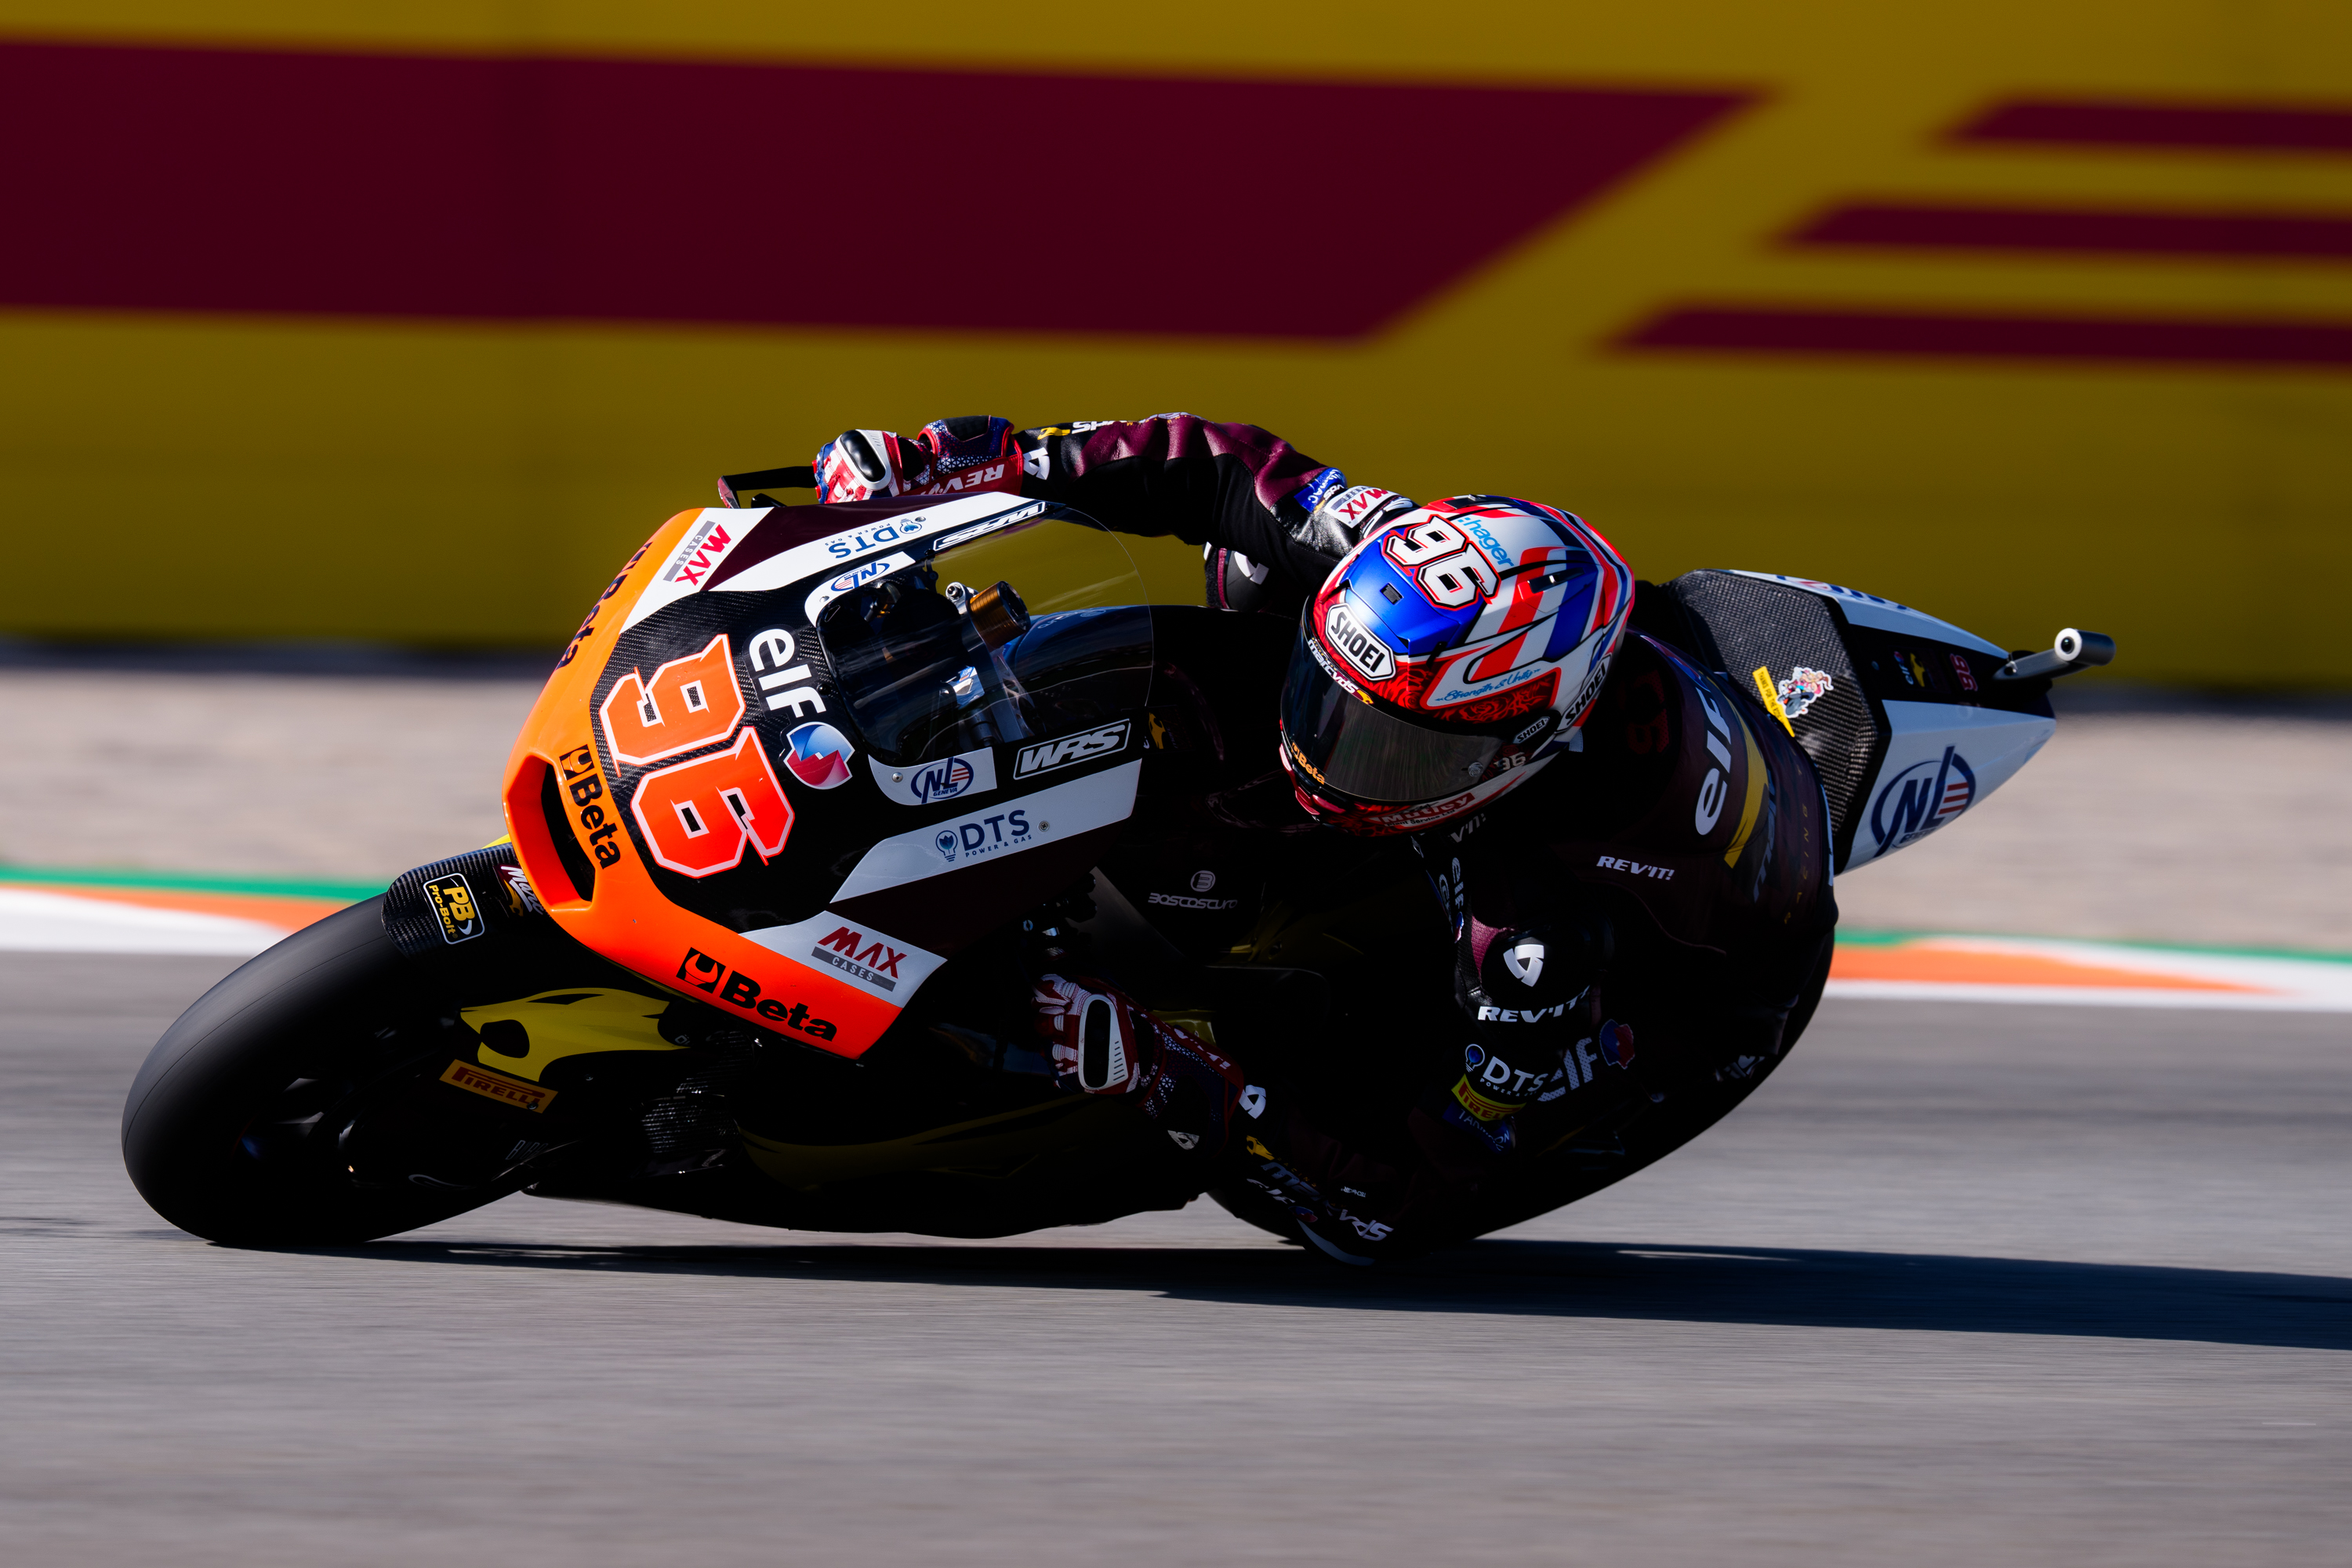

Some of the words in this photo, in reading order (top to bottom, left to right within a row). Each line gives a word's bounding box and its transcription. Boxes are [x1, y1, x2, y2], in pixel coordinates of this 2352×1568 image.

[1338, 488, 1388, 521] MAX
[828, 526, 899, 558] DTS
[865, 523, 890, 534] POWER
[938, 503, 1039, 549] WRS
[674, 524, 732, 586] MAX
[676, 535, 703, 566] CASES
[1382, 514, 1501, 612] 96
[1330, 612, 1386, 673] SHOEI
[749, 628, 826, 718] elf
[1949, 653, 1979, 691] 96
[1564, 662, 1606, 725] SHOEI
[1019, 724, 1127, 774] WRS
[1517, 719, 1545, 742] SHOEI
[599, 633, 795, 878] 96
[1494, 751, 1526, 772] 96
[1694, 687, 1733, 836] elf
[933, 786, 958, 797] GENEVA
[568, 772, 621, 869] Beta
[960, 810, 1030, 851] DTS
[965, 844, 999, 858] POWER
[1014, 834, 1033, 844] GAS
[1596, 855, 1675, 880] REV'IT!
[443, 886, 476, 922] PB
[818, 926, 907, 979] MAX
[832, 956, 874, 982] CASES
[719, 970, 837, 1042] Beta
[452, 1066, 546, 1105] PIRELLI
[1479, 1077, 1512, 1098] POWER
[1483, 1055, 1549, 1092] DTS
